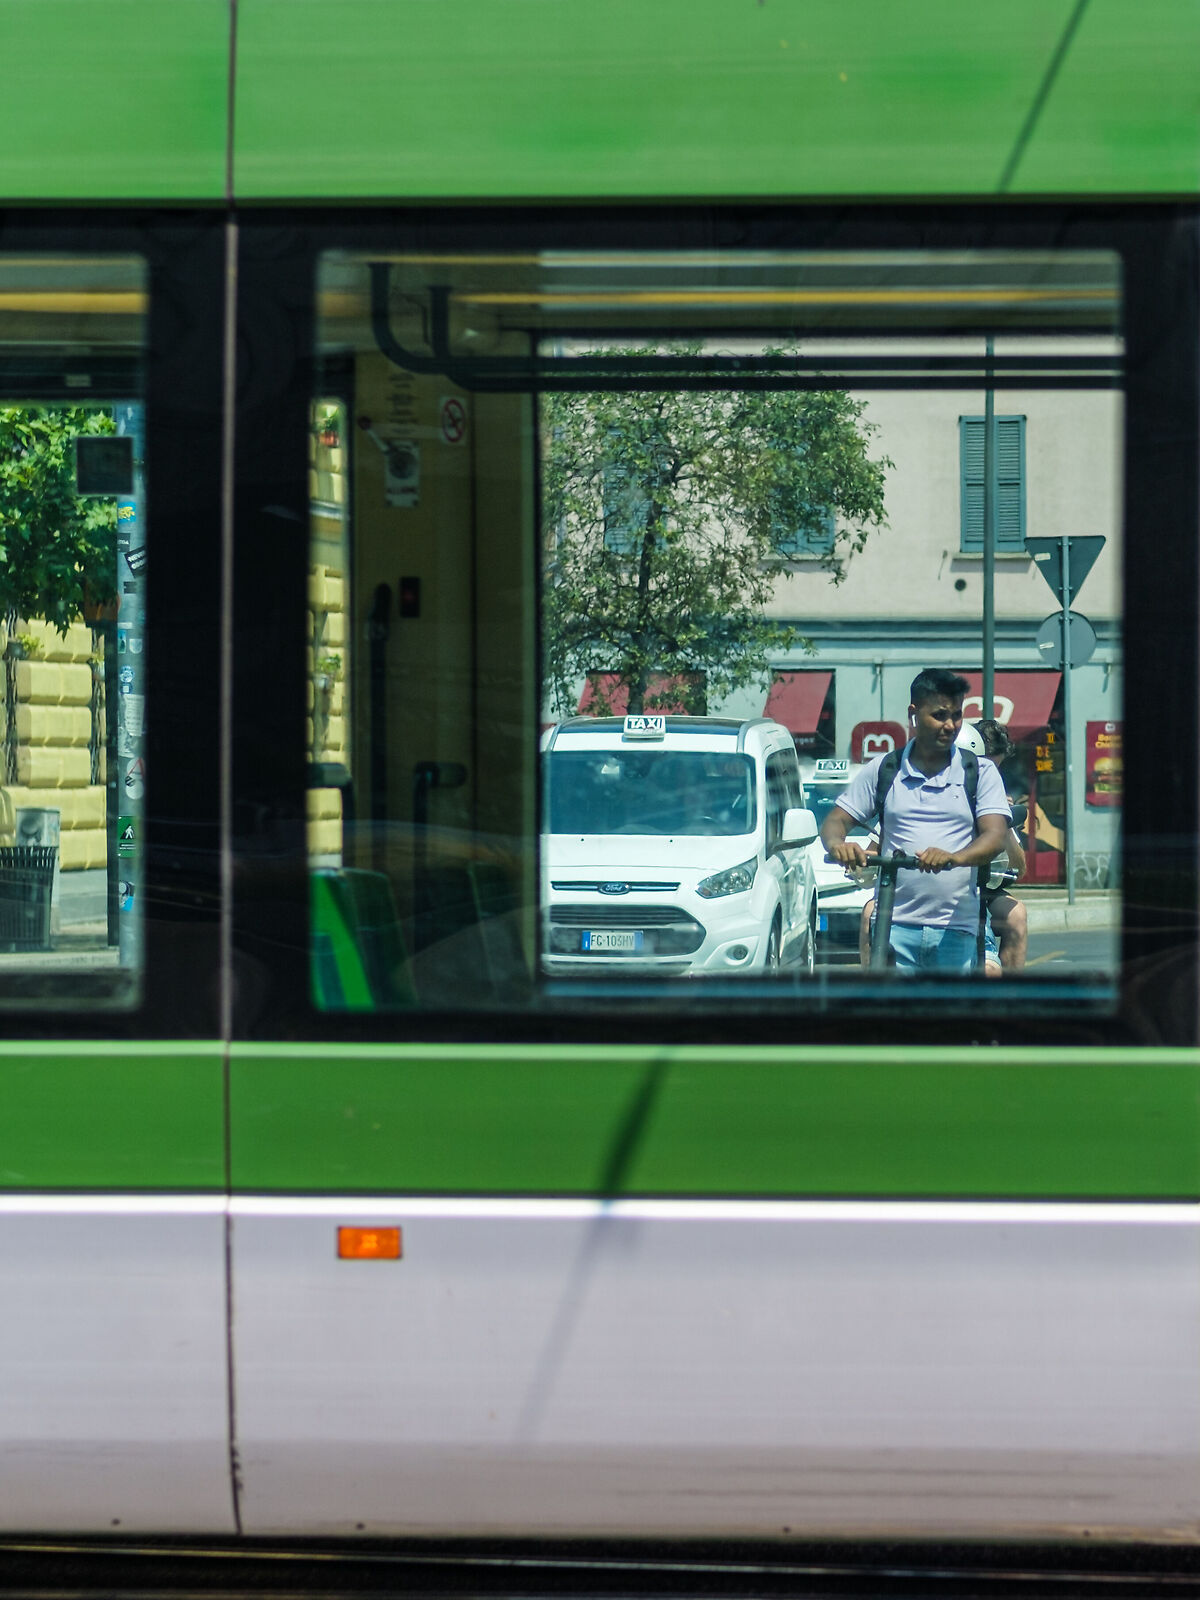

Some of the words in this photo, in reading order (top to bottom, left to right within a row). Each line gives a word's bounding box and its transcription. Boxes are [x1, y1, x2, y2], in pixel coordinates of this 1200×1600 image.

[628, 718, 661, 729] TAXI
[819, 761, 846, 770] TAXI
[605, 884, 623, 892] Ford
